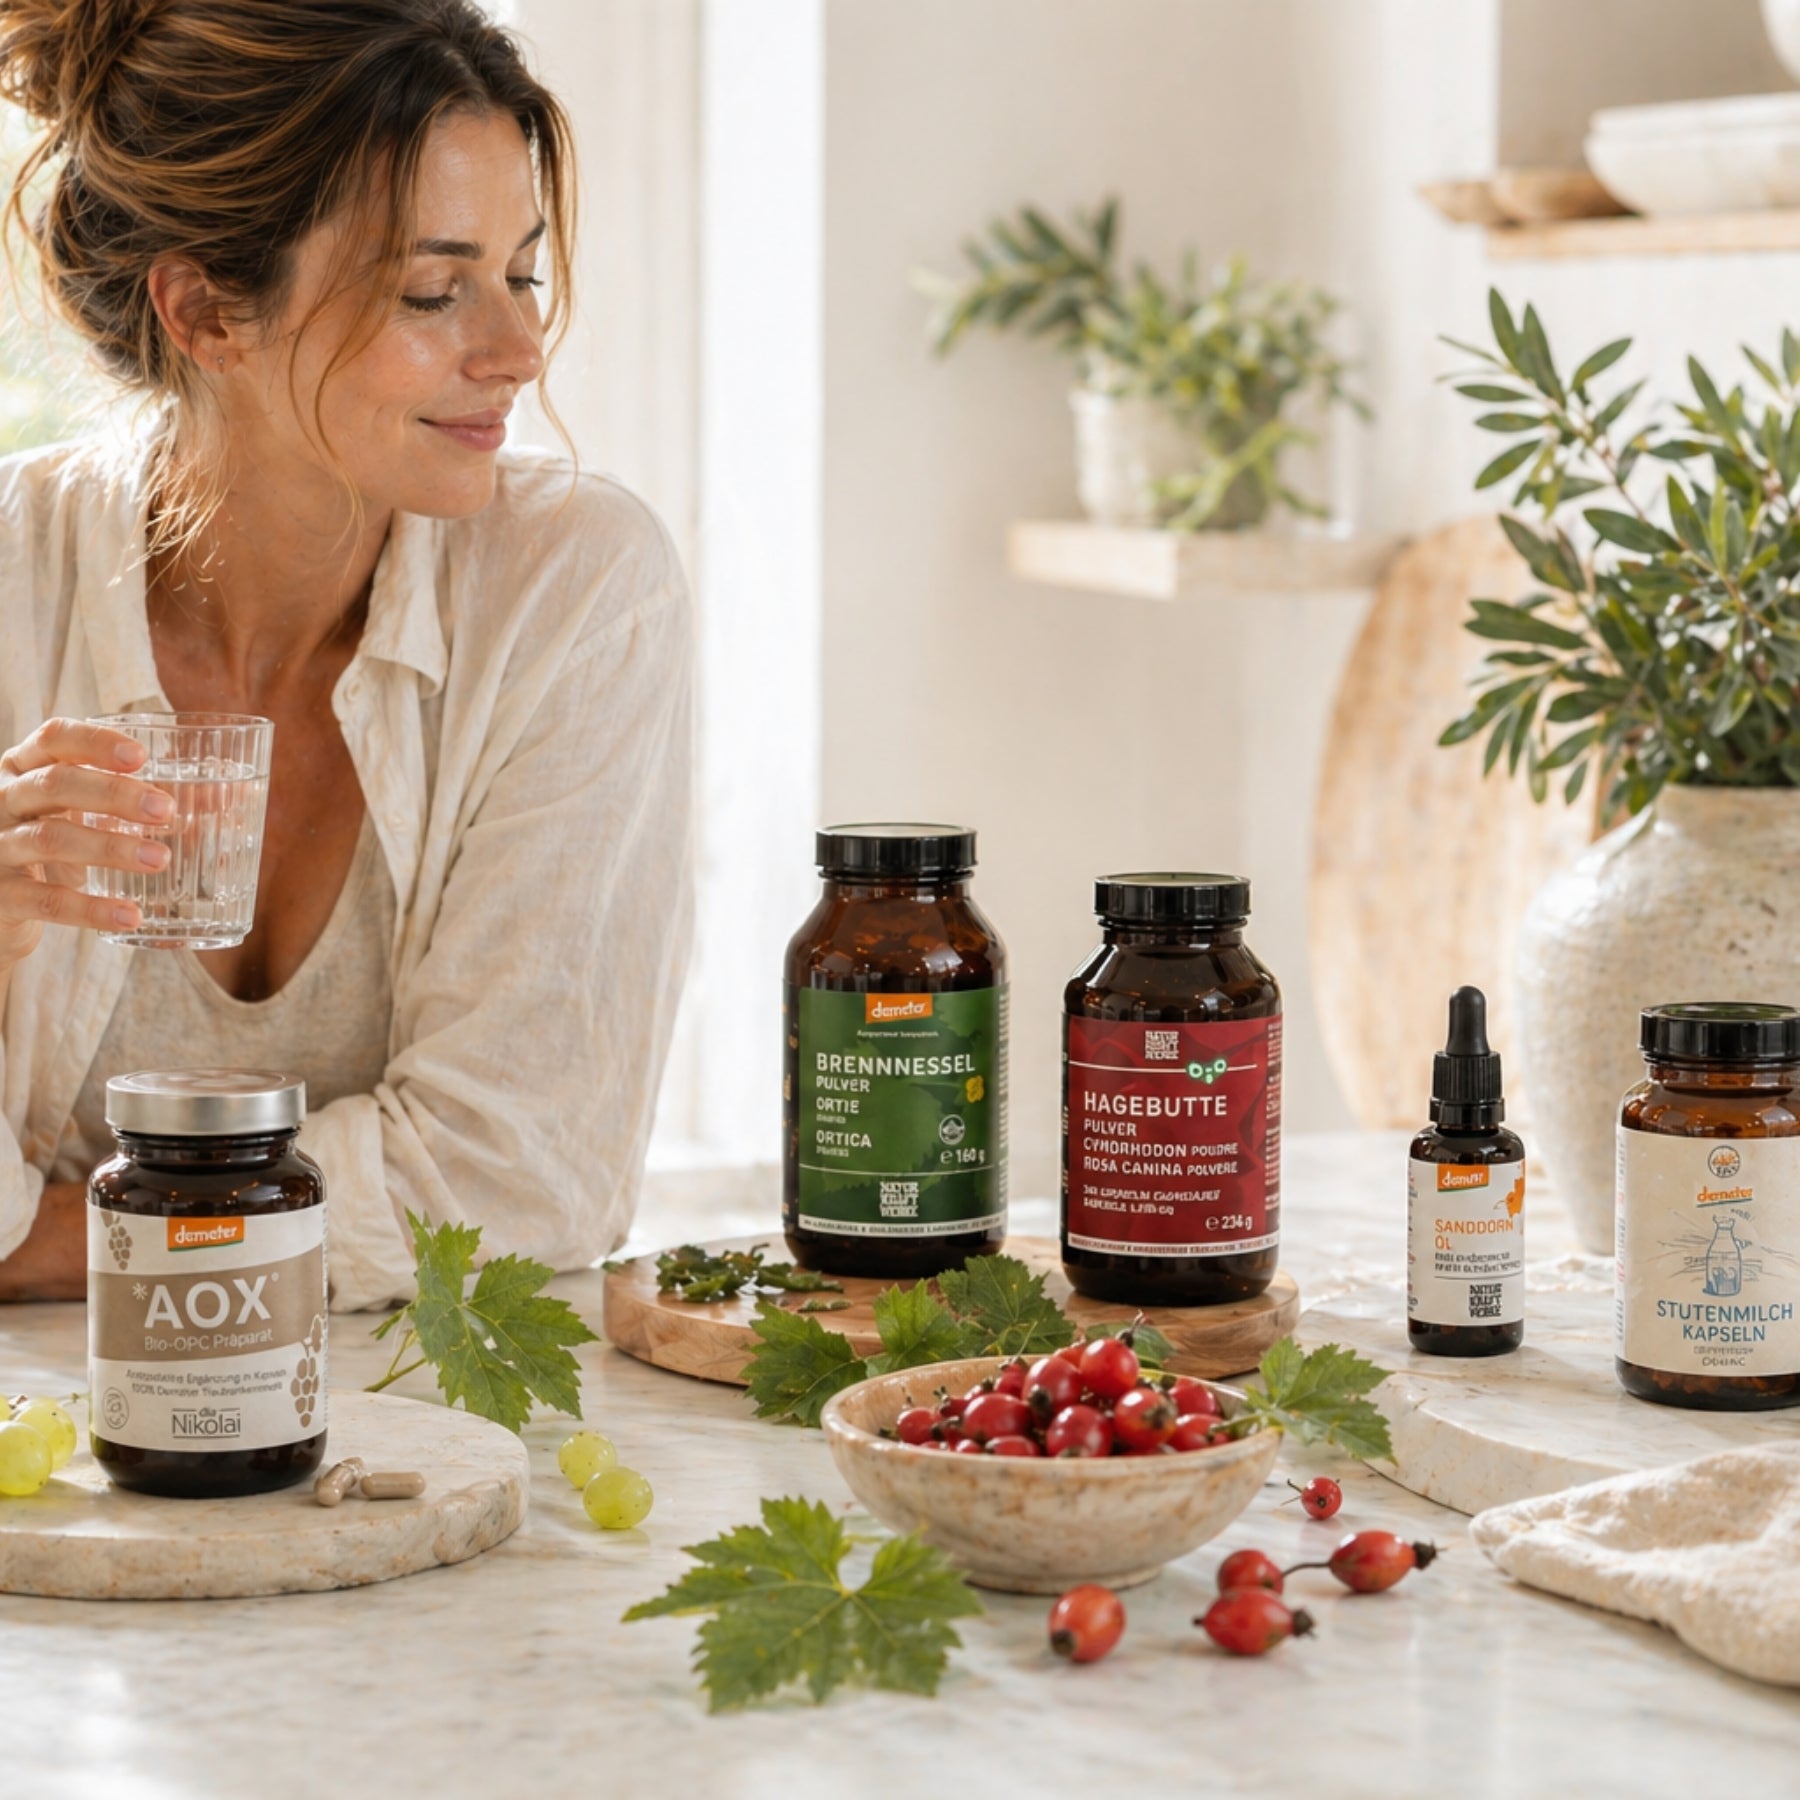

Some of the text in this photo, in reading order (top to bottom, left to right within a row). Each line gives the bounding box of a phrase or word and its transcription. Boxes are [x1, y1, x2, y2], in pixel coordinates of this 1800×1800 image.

[816, 1052, 976, 1076] BRENNNESSEL
[816, 1076, 871, 1093] PULVER
[816, 1096, 860, 1114] ORTIE
[1084, 1090, 1227, 1117] HAGEBUTTE
[1083, 1118, 1137, 1136] PULVER
[816, 1130, 872, 1148] ORTICA
[1122, 1160, 1183, 1176] CANINA
[1435, 1218, 1513, 1235] SANDDORN
[1657, 1300, 1793, 1323] STUTENMILCH
[1683, 1324, 1766, 1342] KAPSELN
[144, 1335, 209, 1352] Bio-OPC
[173, 1413, 240, 1434] Nikolai
